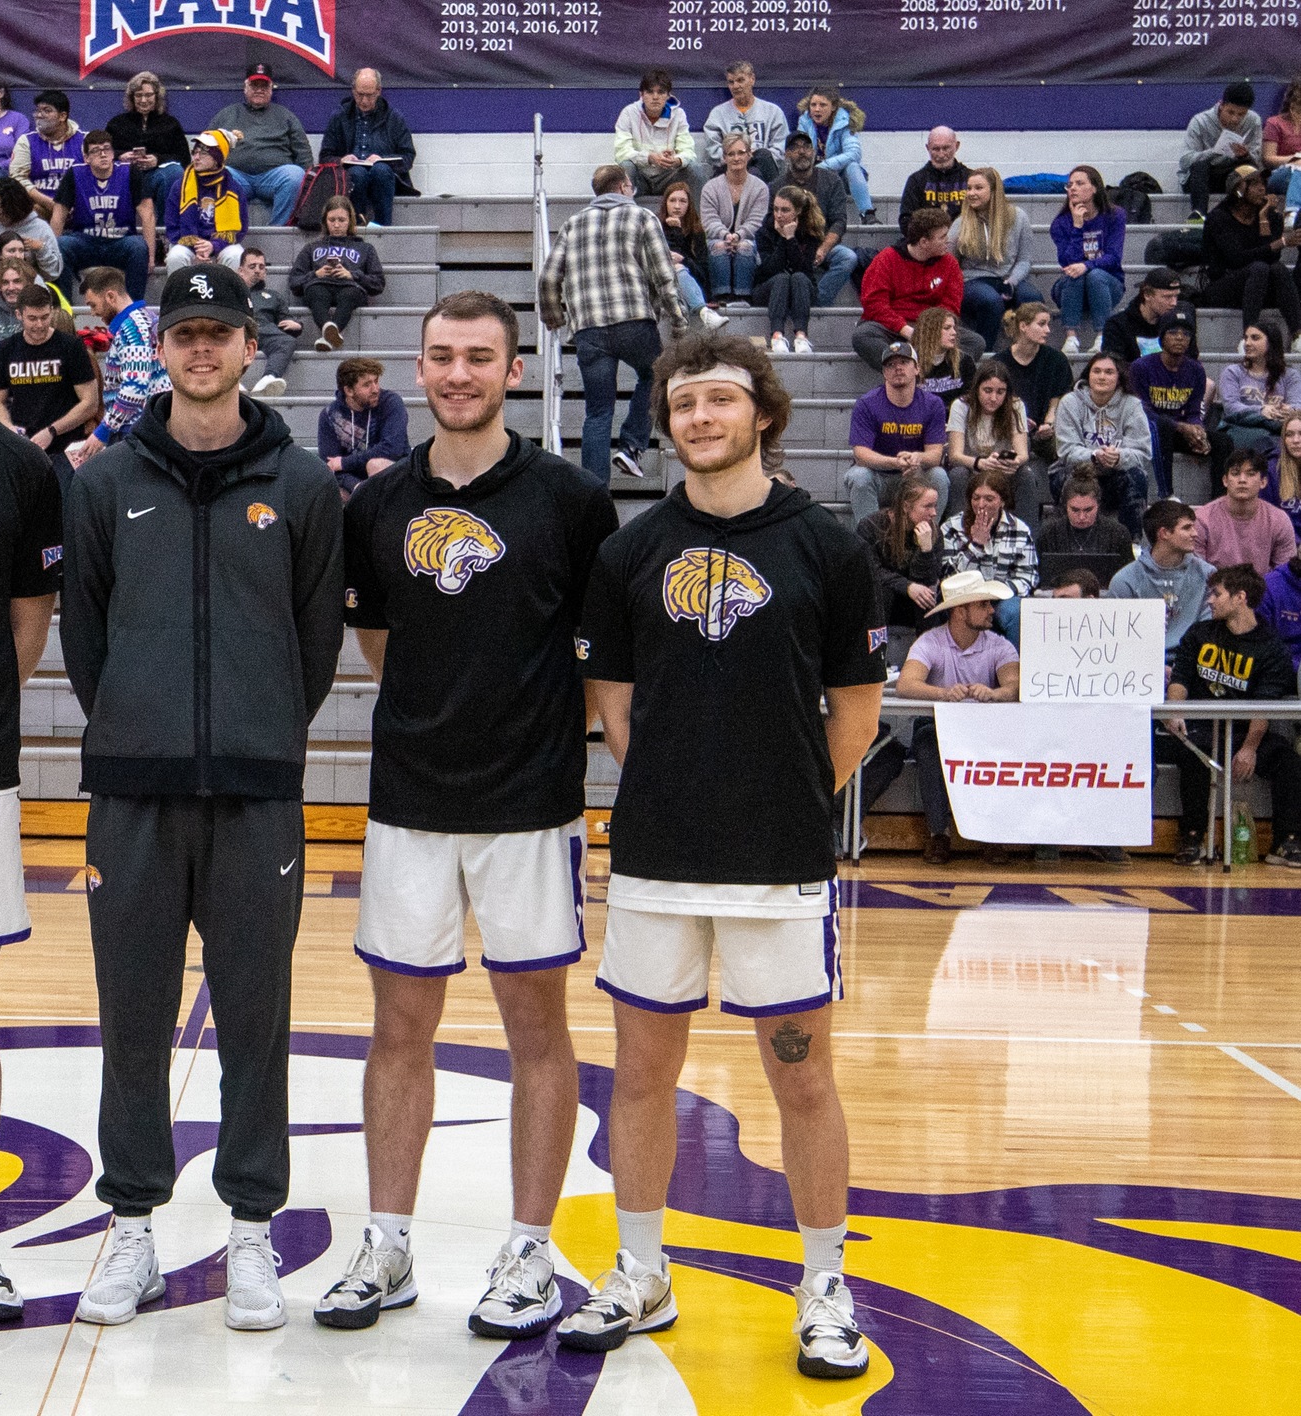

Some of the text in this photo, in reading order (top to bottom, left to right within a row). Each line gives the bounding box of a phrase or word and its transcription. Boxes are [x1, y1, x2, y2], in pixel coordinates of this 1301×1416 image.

[441, 3, 601, 17] 2008, 2010, 2011, 2012,
[669, 0, 831, 15] 2007, 2008, 2009, 2010,
[901, 0, 1066, 12] 2008, 2009, 2010, 2011,
[441, 20, 599, 35] 2013, 2014, 2016, 2017,
[668, 18, 831, 33] 2011, 2012, 2013, 2014,
[900, 16, 977, 31] 2013, 2016
[1133, 14, 1299, 29] 2016, 2017, 2018, 2019,
[441, 38, 513, 52] 2019, 2021
[668, 37, 702, 50] 2016
[1132, 32, 1209, 47] 2020, 2021
[88, 195, 119, 210] OLIVET
[313, 245, 360, 264] ONU
[9, 359, 61, 378] OLIVET
[1033, 611, 1142, 643] THANK
[1070, 642, 1119, 668] YOU
[1197, 643, 1254, 680] ONU
[1029, 670, 1153, 698] SENIORS
